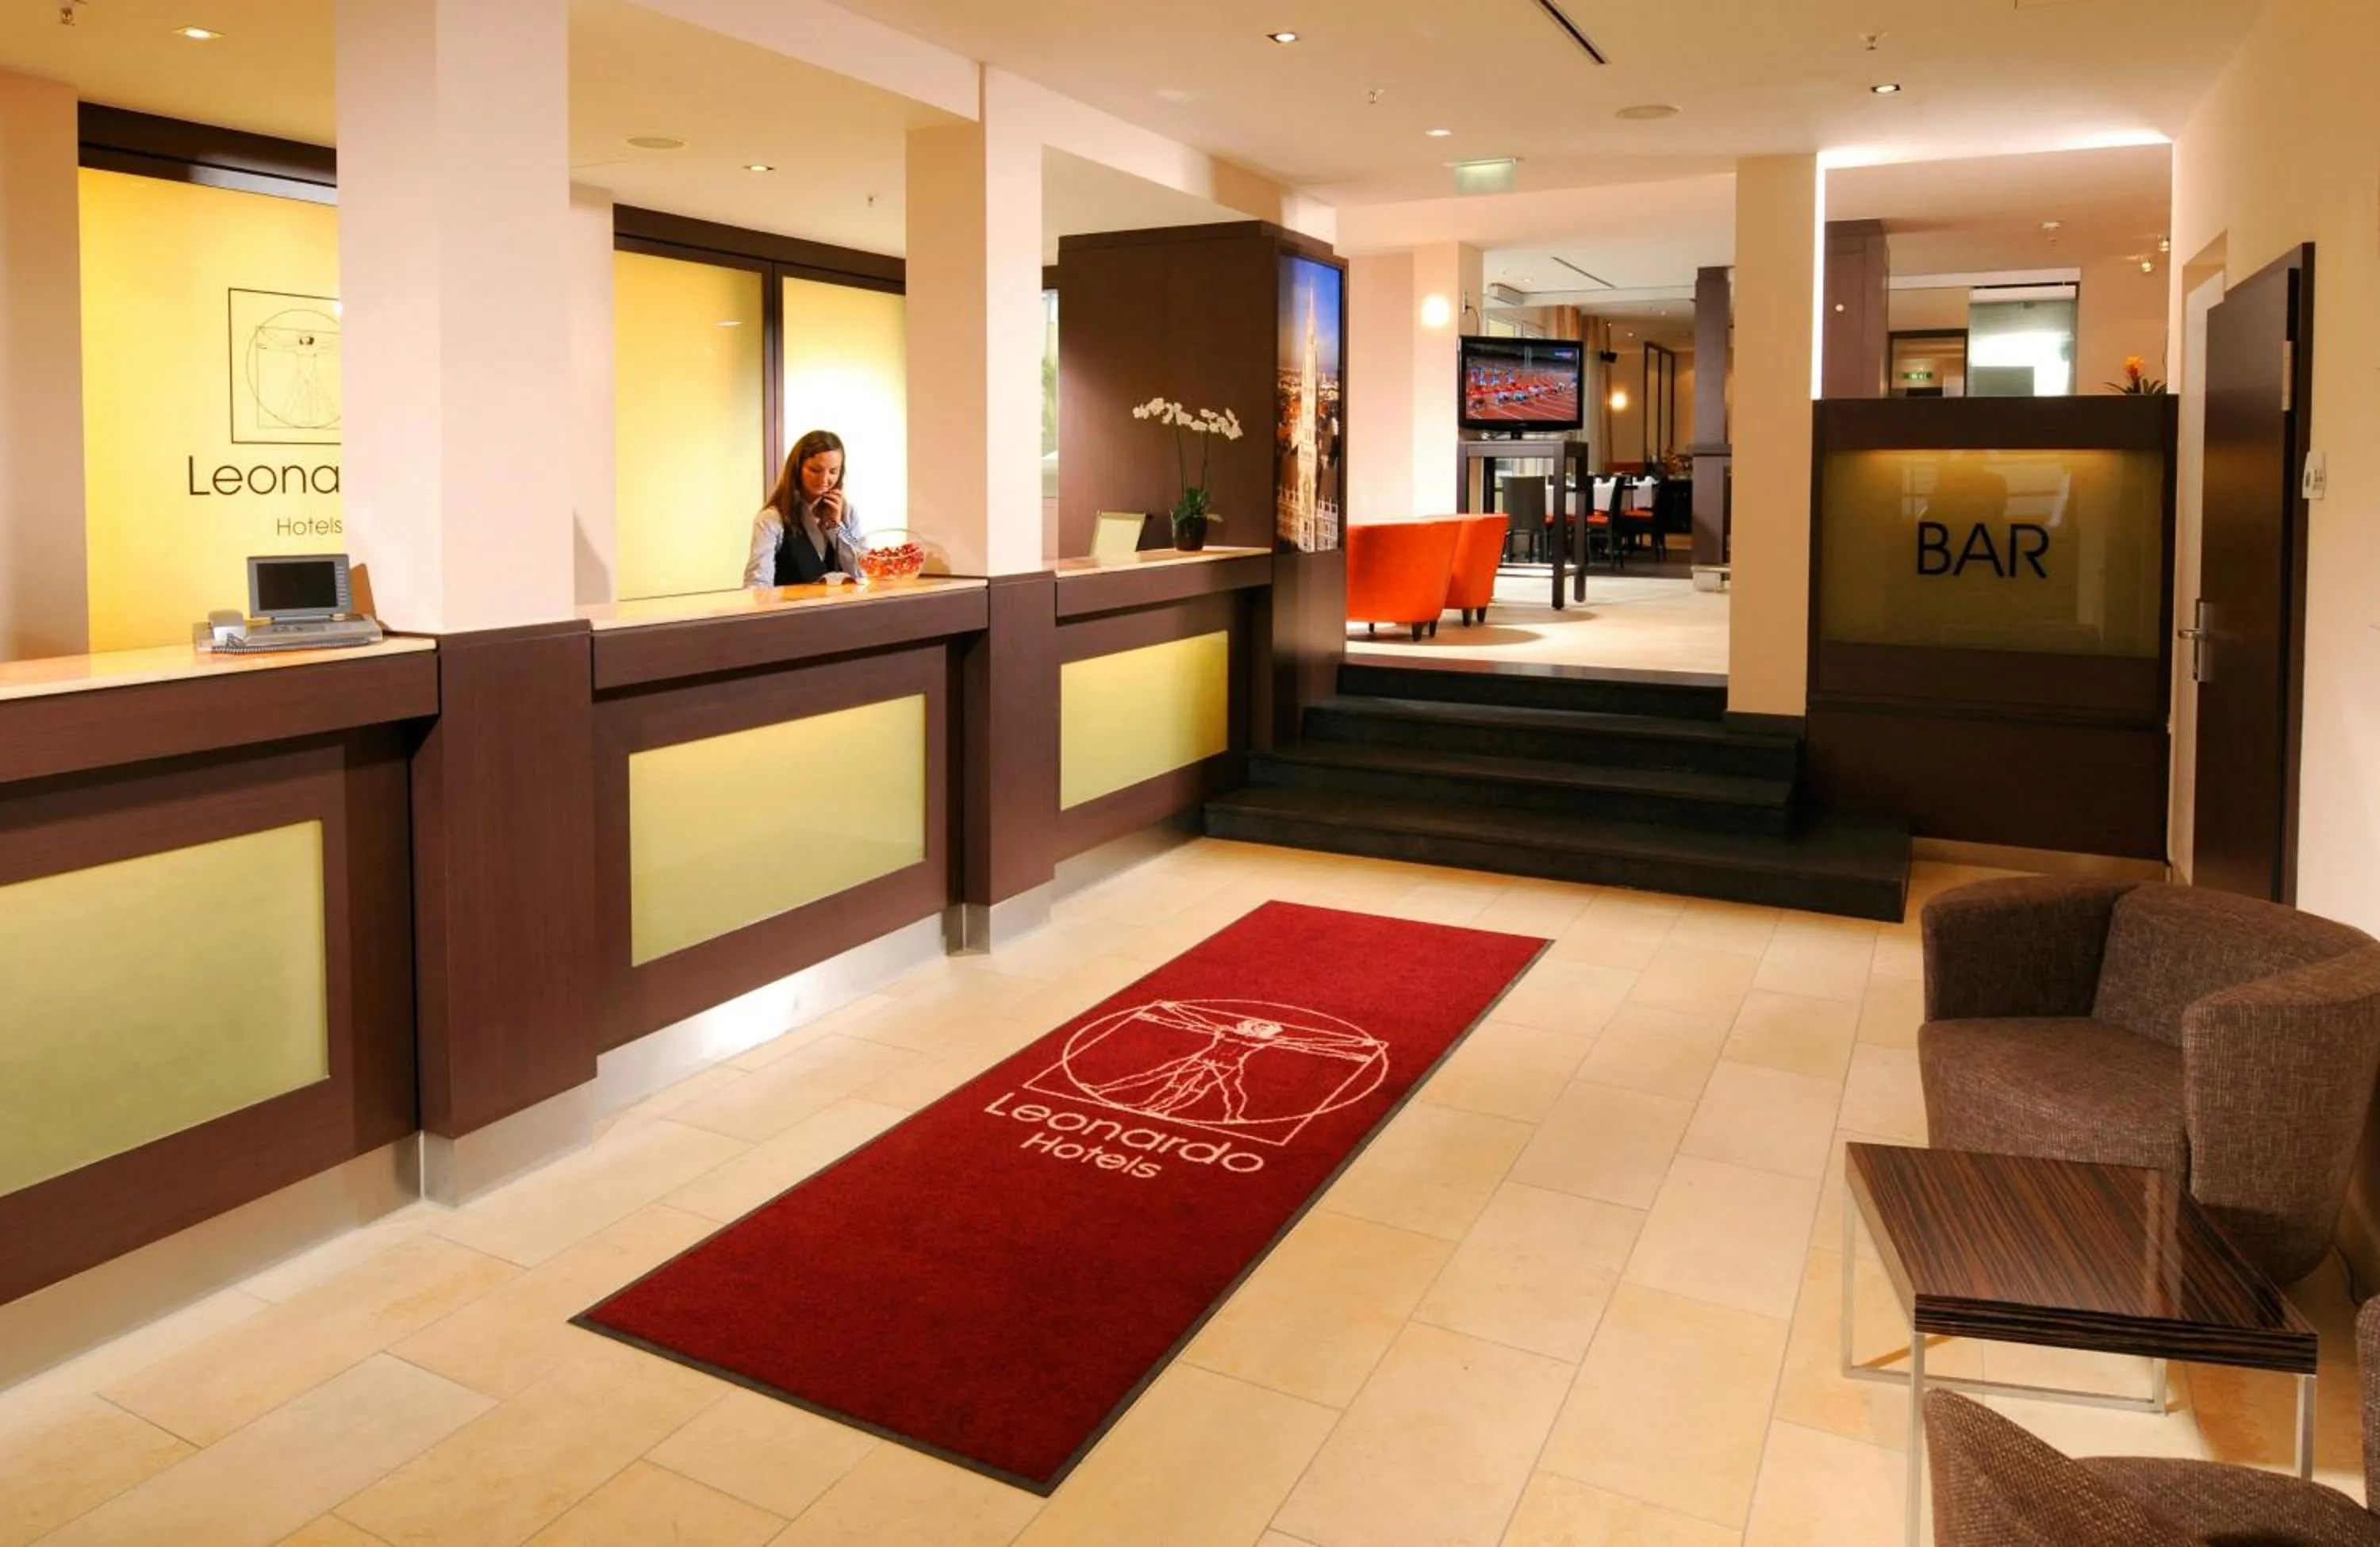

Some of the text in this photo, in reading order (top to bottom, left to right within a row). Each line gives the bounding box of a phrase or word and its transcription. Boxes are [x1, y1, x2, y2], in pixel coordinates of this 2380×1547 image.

[189, 455, 340, 495] Leona
[277, 516, 343, 536] Hotels
[1917, 521, 2049, 579] BAR
[984, 1092, 1264, 1173] Leonardo
[1019, 1132, 1161, 1179] Hotels
